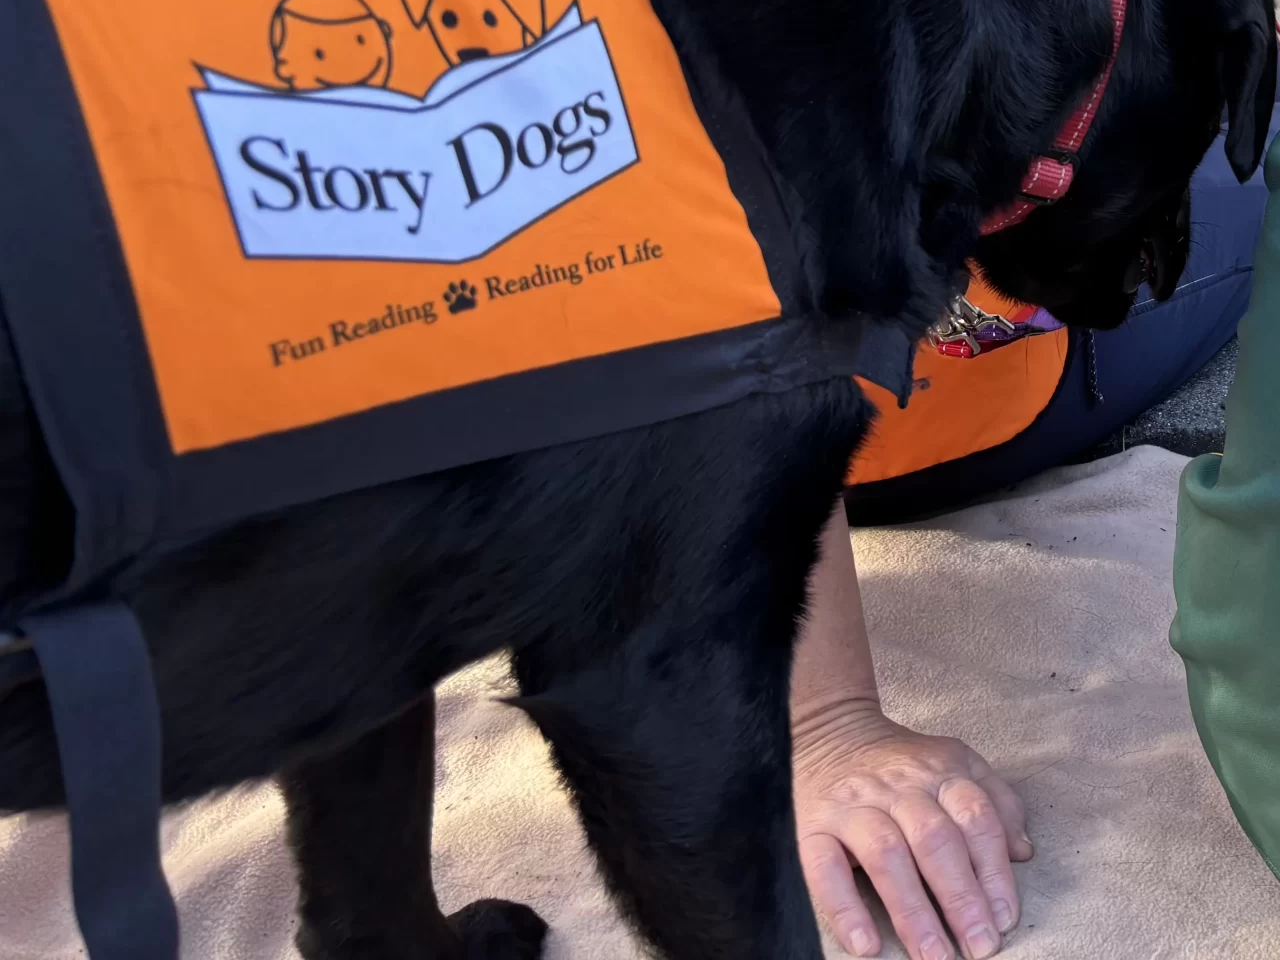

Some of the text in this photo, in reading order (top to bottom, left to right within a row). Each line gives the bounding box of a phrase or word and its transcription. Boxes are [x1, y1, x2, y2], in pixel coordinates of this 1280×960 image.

[239, 91, 613, 235] Story Dogs
[268, 238, 663, 368] Fun Reading Reading for Life
